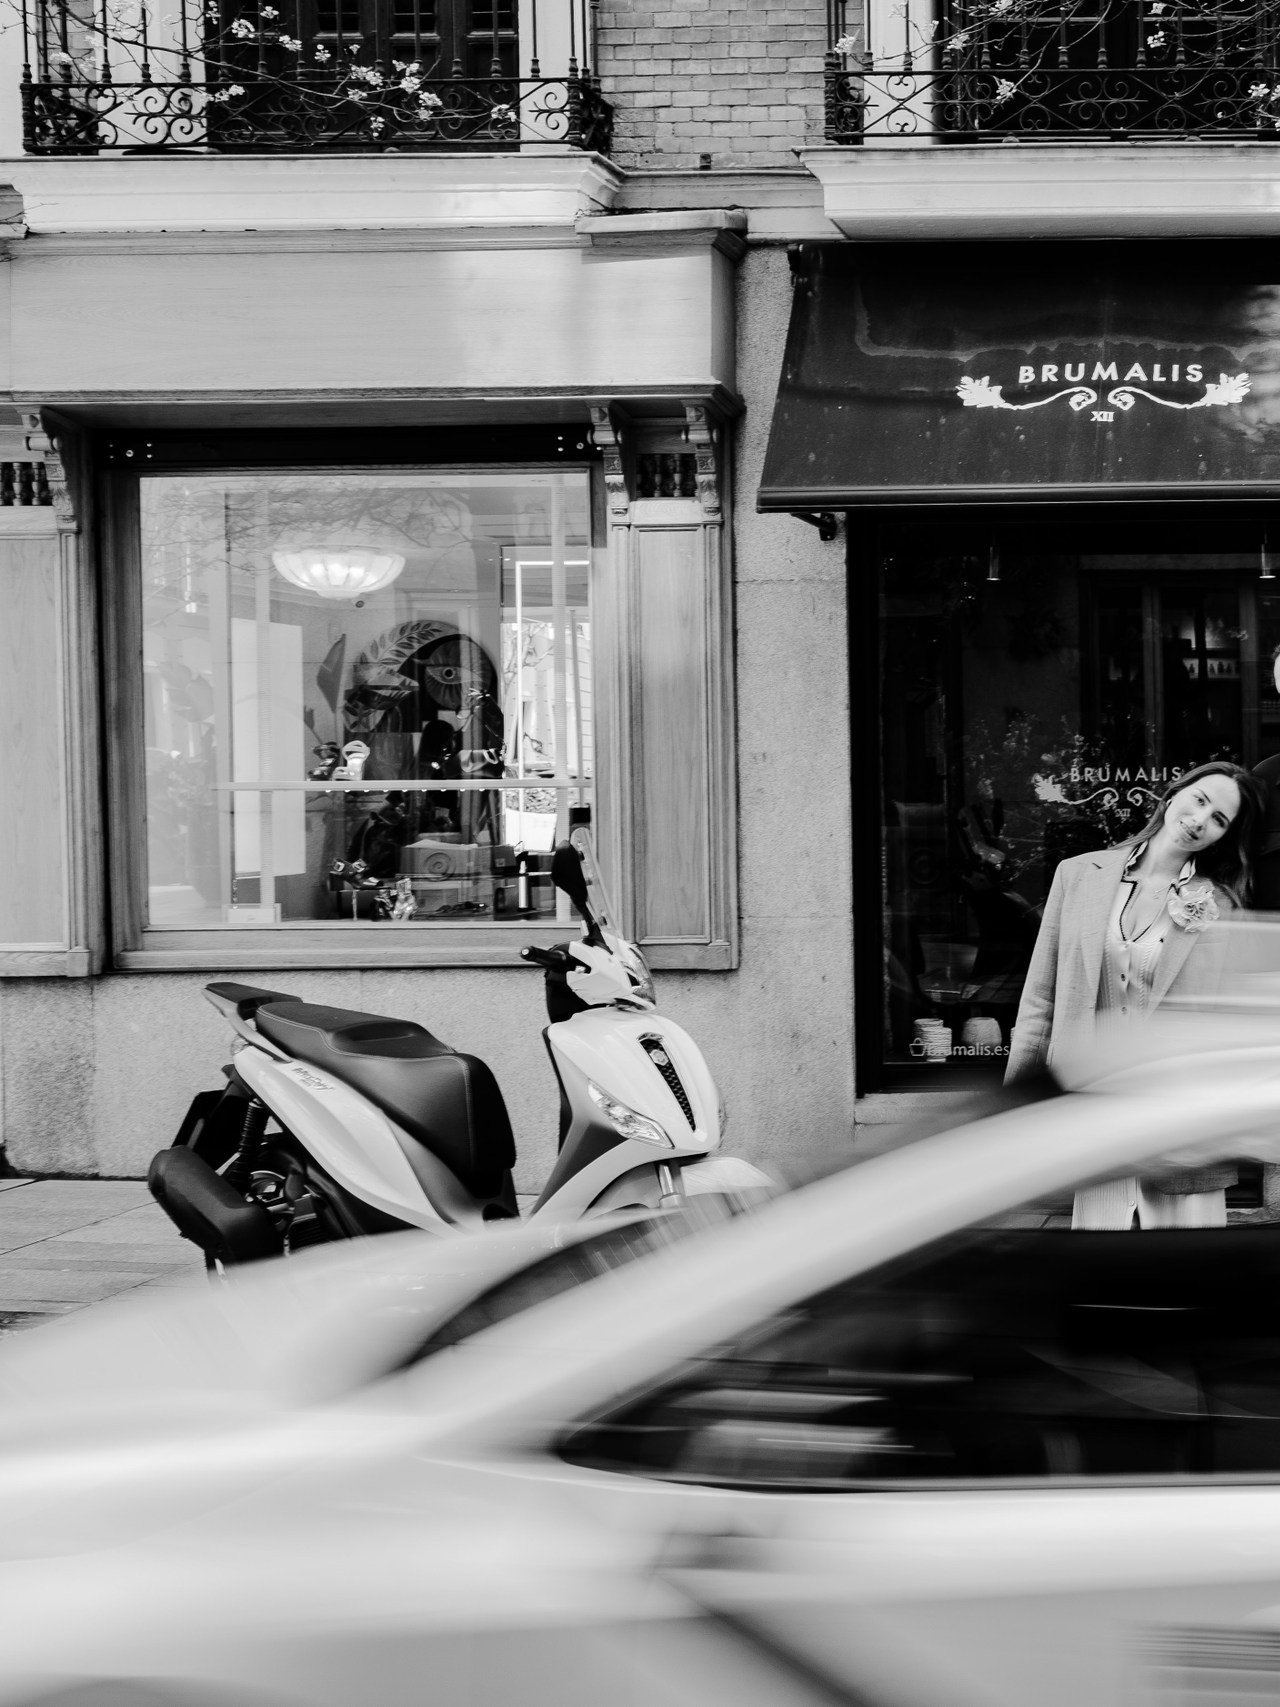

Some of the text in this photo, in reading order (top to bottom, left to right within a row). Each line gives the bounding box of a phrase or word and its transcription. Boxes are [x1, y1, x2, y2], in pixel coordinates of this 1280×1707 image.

[1018, 361, 1204, 384] BRUMALIS
[1090, 411, 1115, 422] XII
[1070, 766, 1182, 782] BRUMALIS
